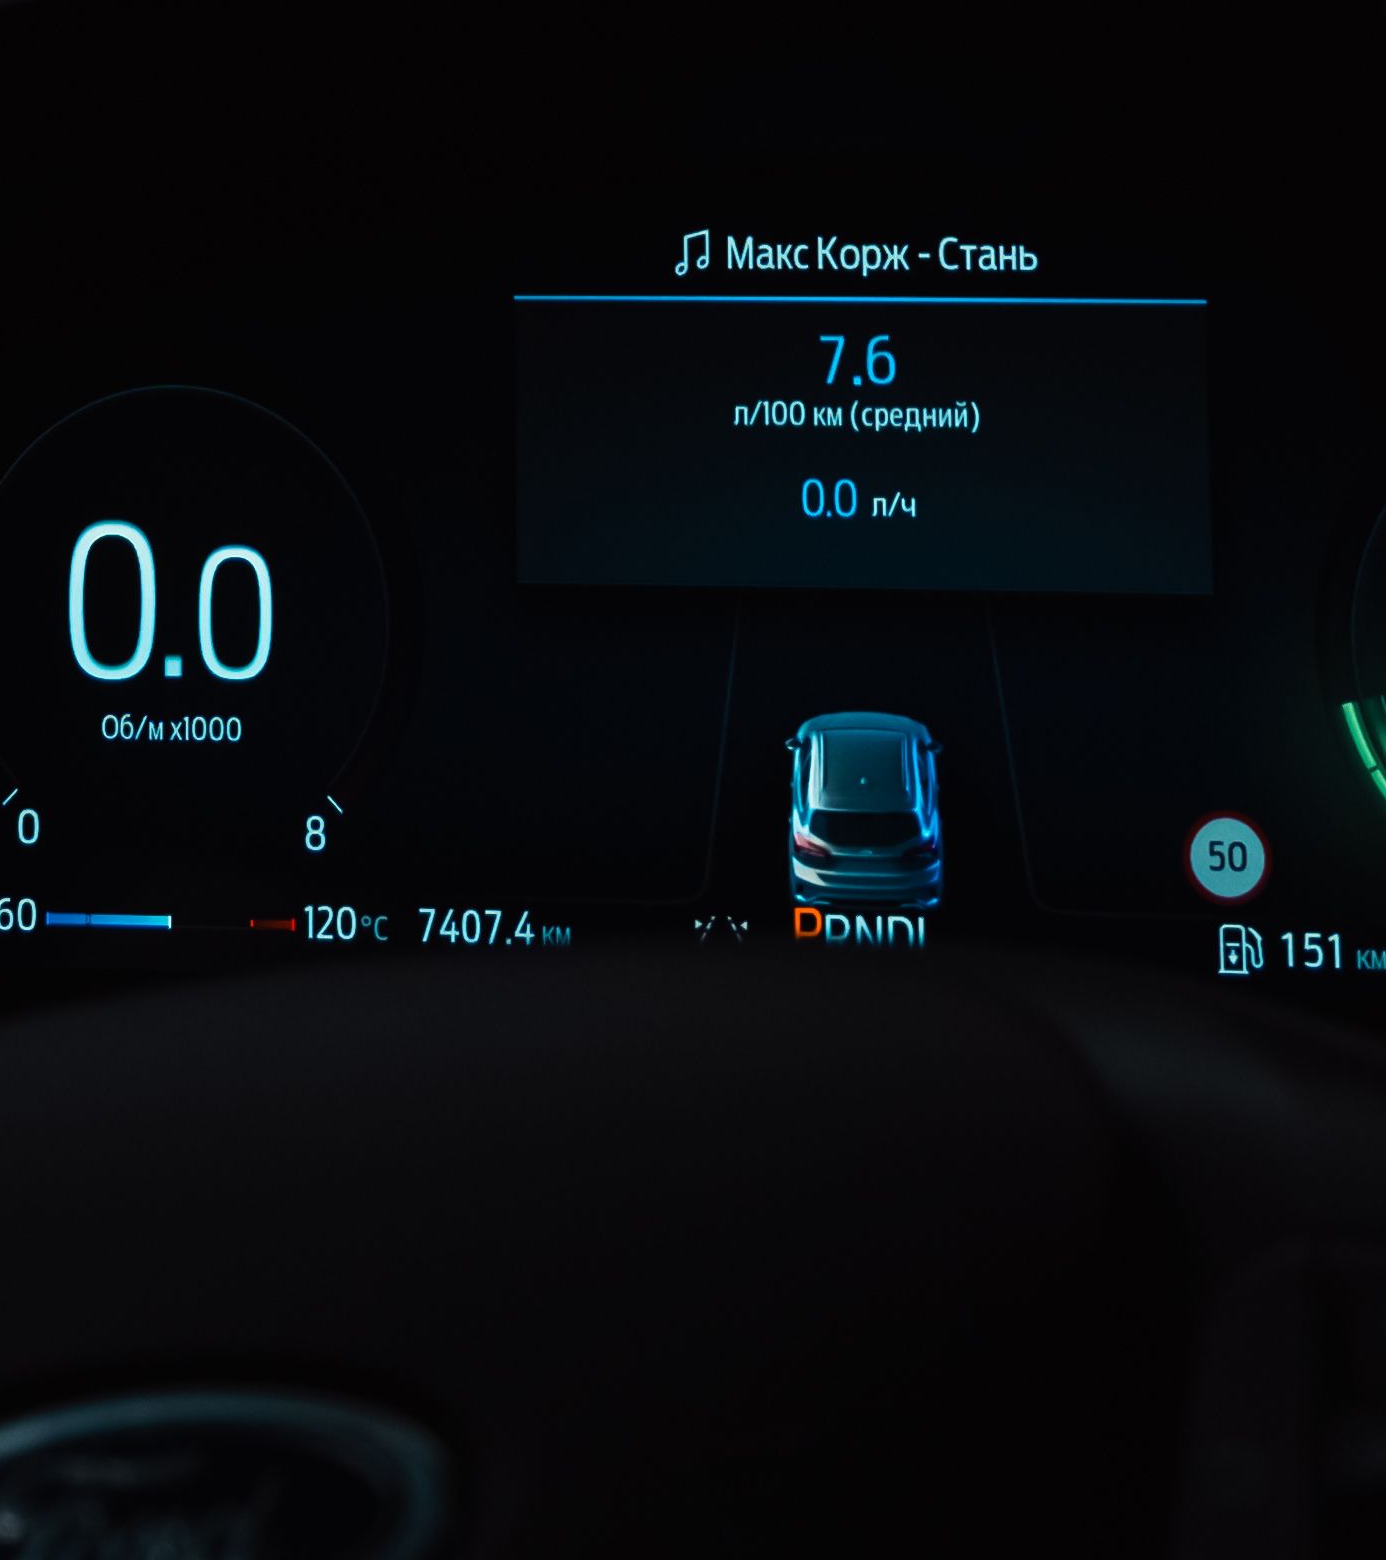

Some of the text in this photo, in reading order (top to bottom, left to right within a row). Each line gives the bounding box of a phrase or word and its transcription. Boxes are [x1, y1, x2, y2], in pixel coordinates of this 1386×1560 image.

[727, 235, 809, 270] Макс
[817, 235, 910, 278] Корж
[938, 236, 1038, 271] Стань
[819, 334, 897, 387] 7.6
[733, 400, 980, 434] л/100 км (средний)
[801, 477, 917, 519] 0.0 л/ч
[68, 520, 273, 681] 0.0
[17, 808, 40, 845] 0
[304, 815, 326, 852] 8
[1208, 840, 1248, 873] 50
[418, 907, 535, 945] 7407.4
[1281, 931, 1342, 969] 151
